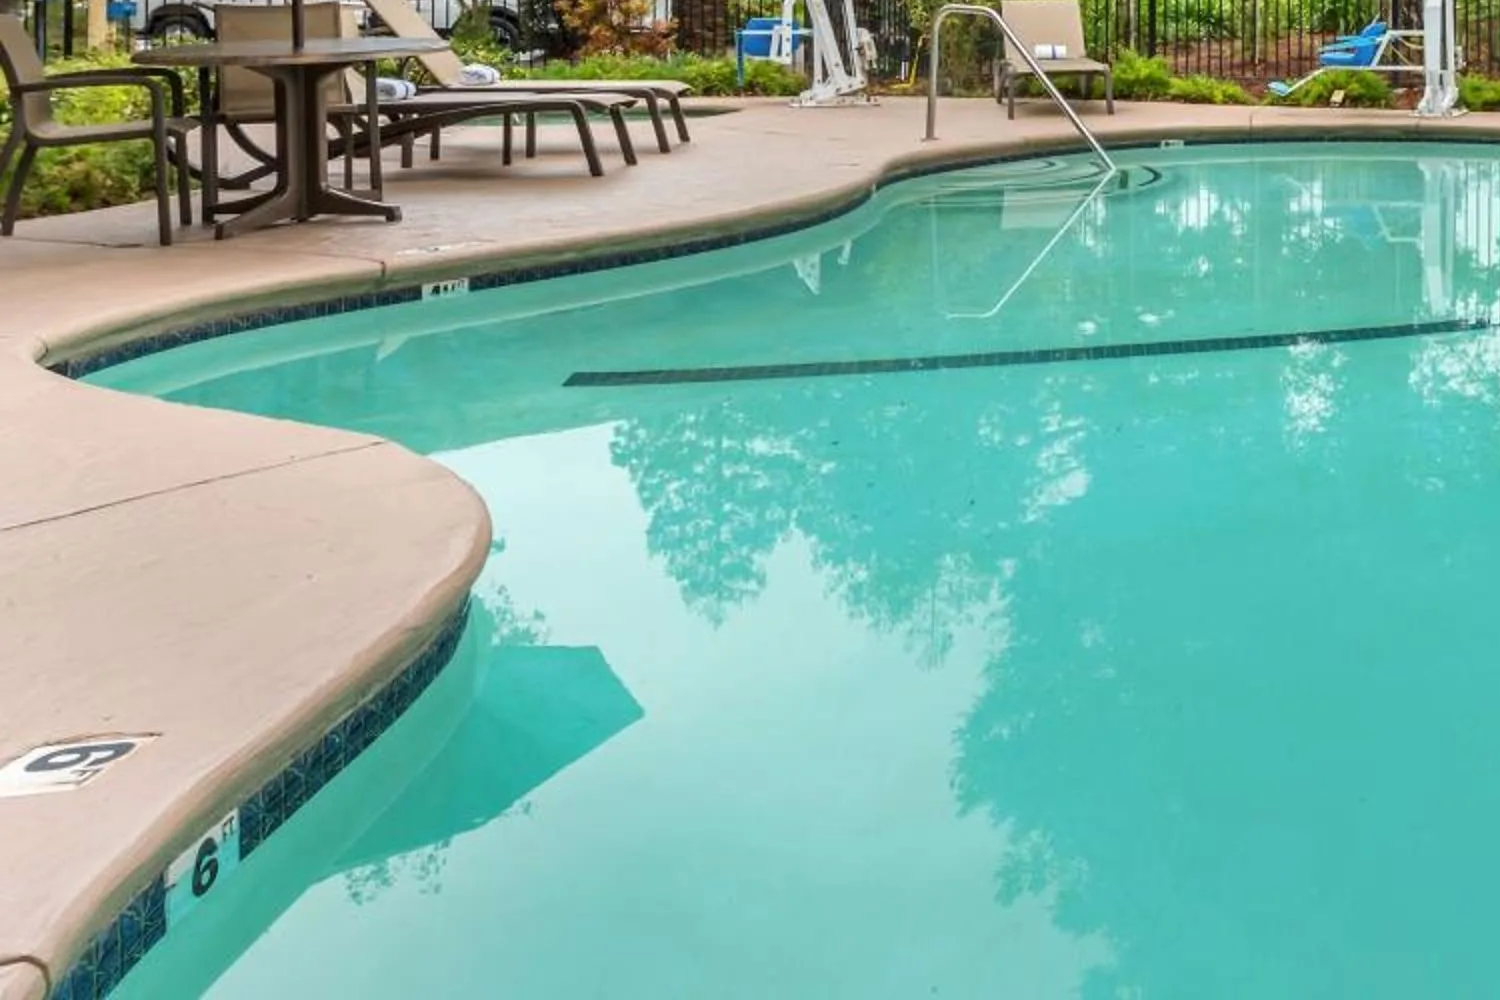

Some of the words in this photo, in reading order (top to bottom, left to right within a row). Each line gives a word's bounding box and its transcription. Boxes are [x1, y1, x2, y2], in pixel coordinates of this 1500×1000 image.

[23, 741, 138, 773] 6
[191, 836, 219, 898] 6
[222, 815, 235, 842] FT
